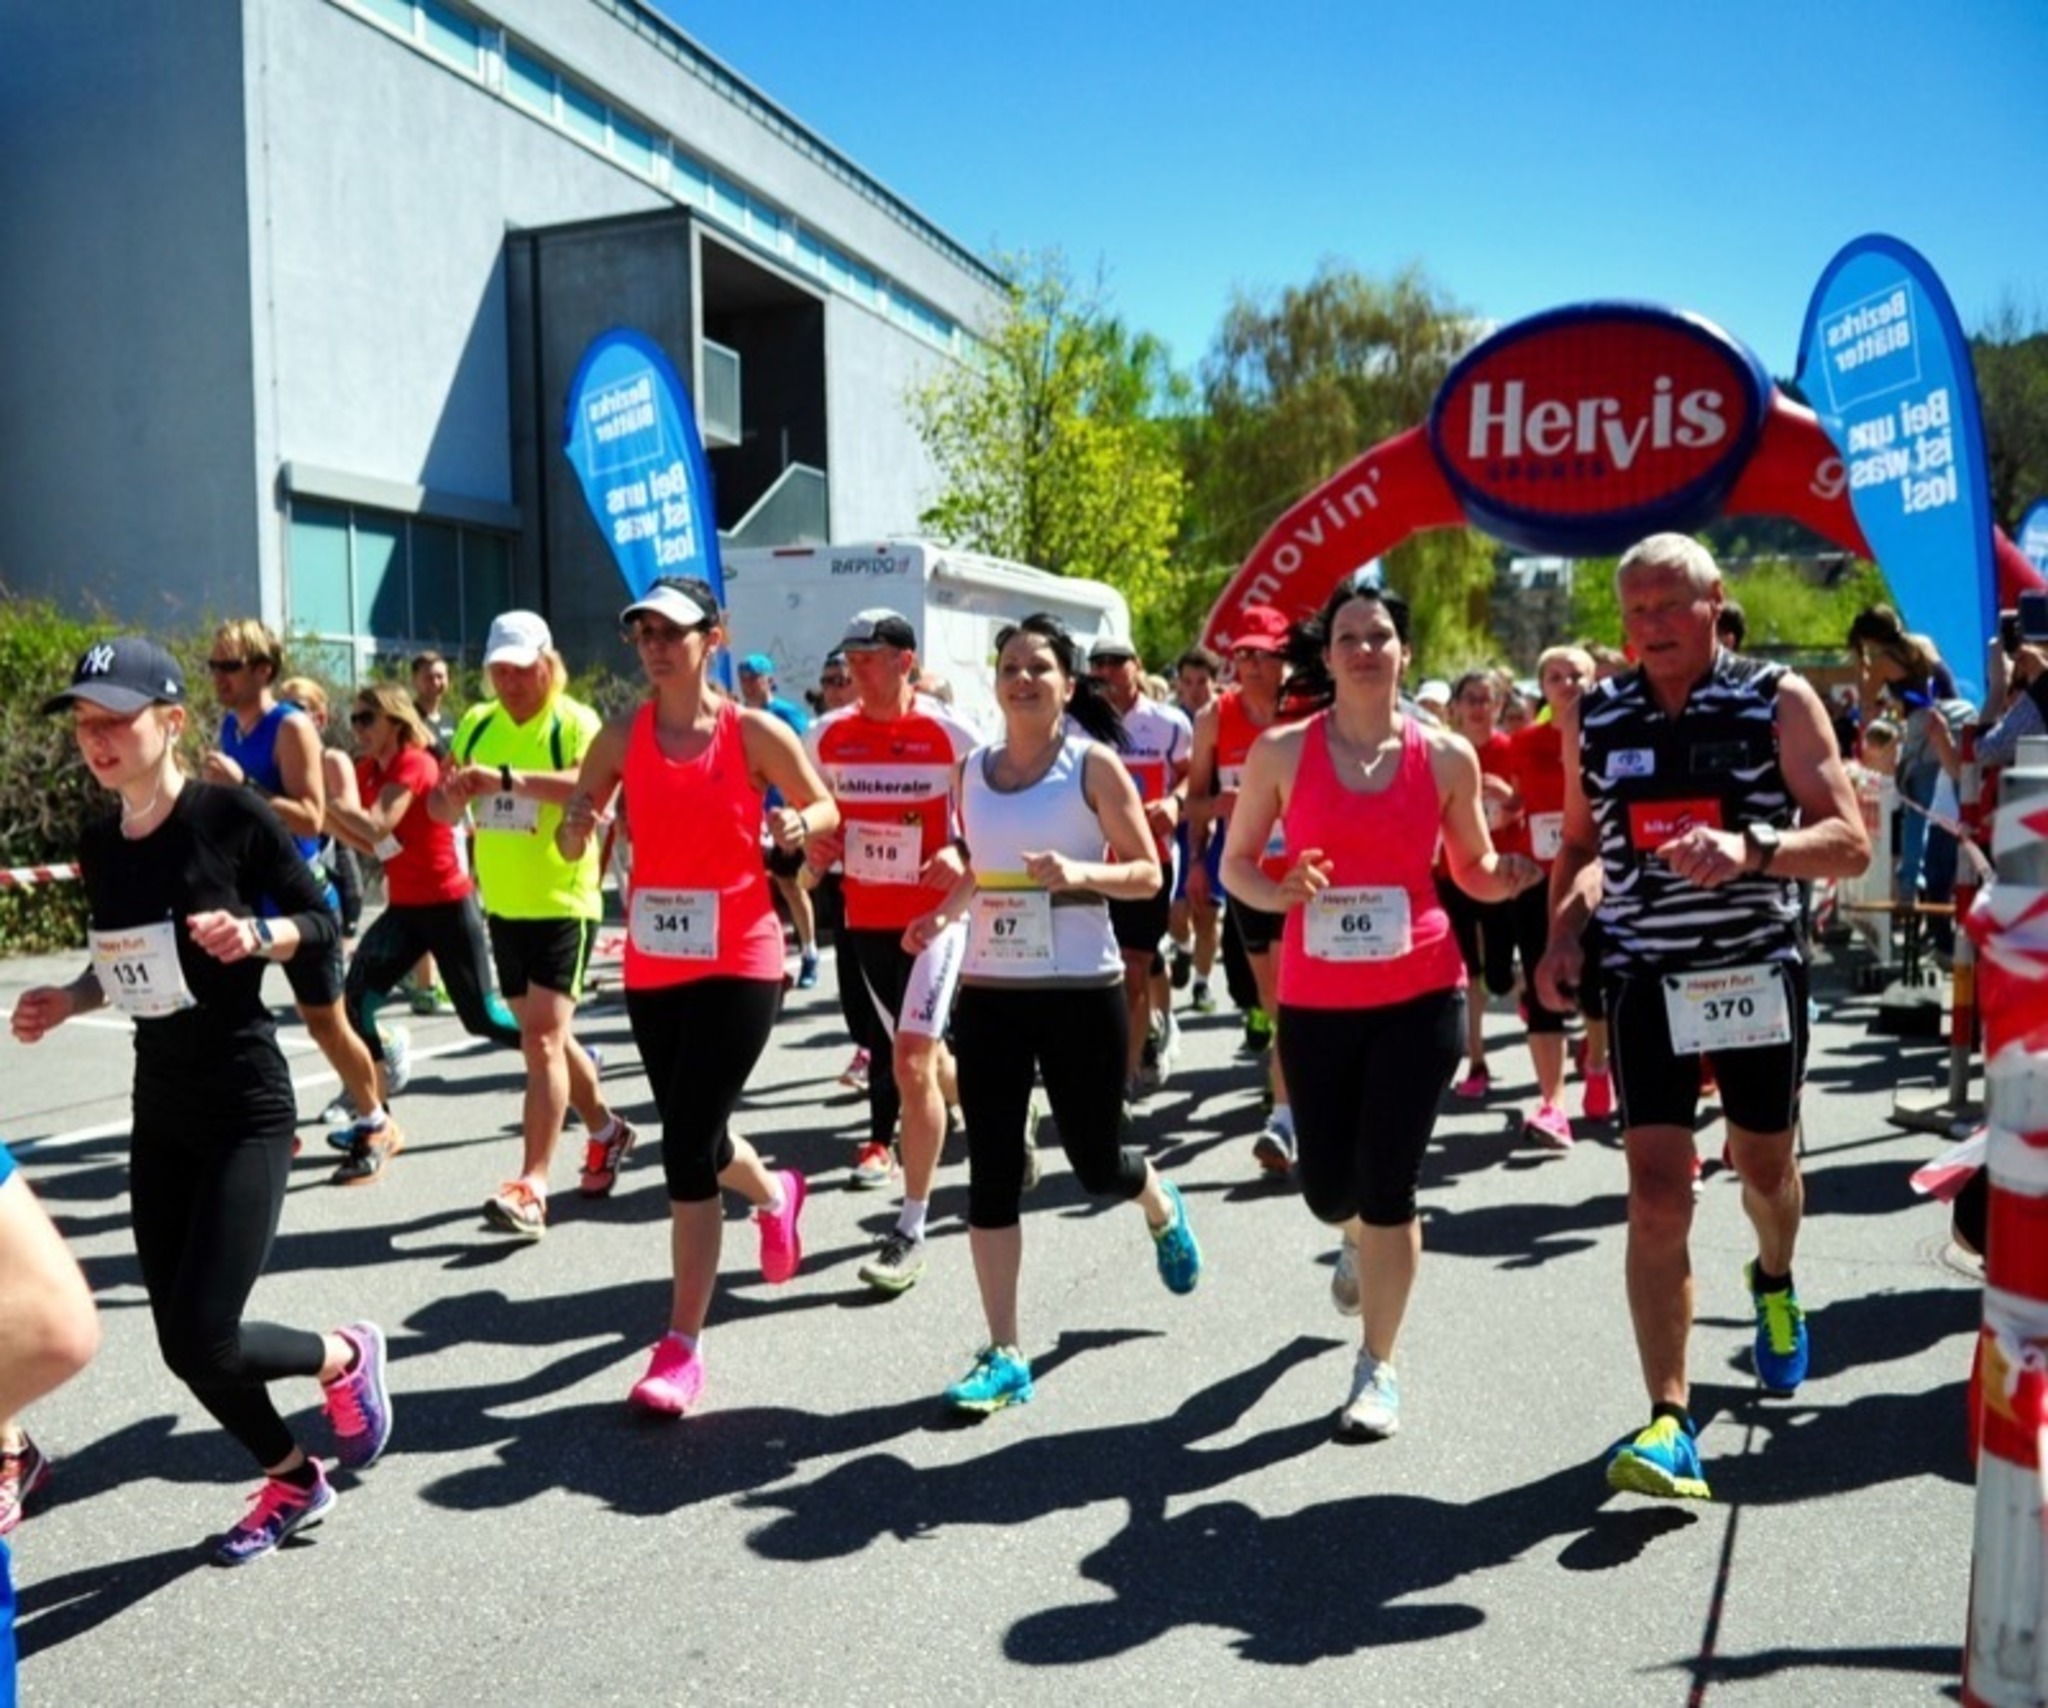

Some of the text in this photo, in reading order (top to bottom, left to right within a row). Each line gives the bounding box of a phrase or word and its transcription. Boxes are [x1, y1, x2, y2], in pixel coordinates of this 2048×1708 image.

[1467, 375, 1727, 470] Hervis
[864, 844, 898, 861] 518
[654, 913, 690, 933] 341
[993, 918, 1018, 936] 67
[1340, 913, 1372, 934] 66
[113, 962, 149, 985] 131
[1729, 974, 1755, 986] Run
[1702, 996, 1755, 1022] 370
